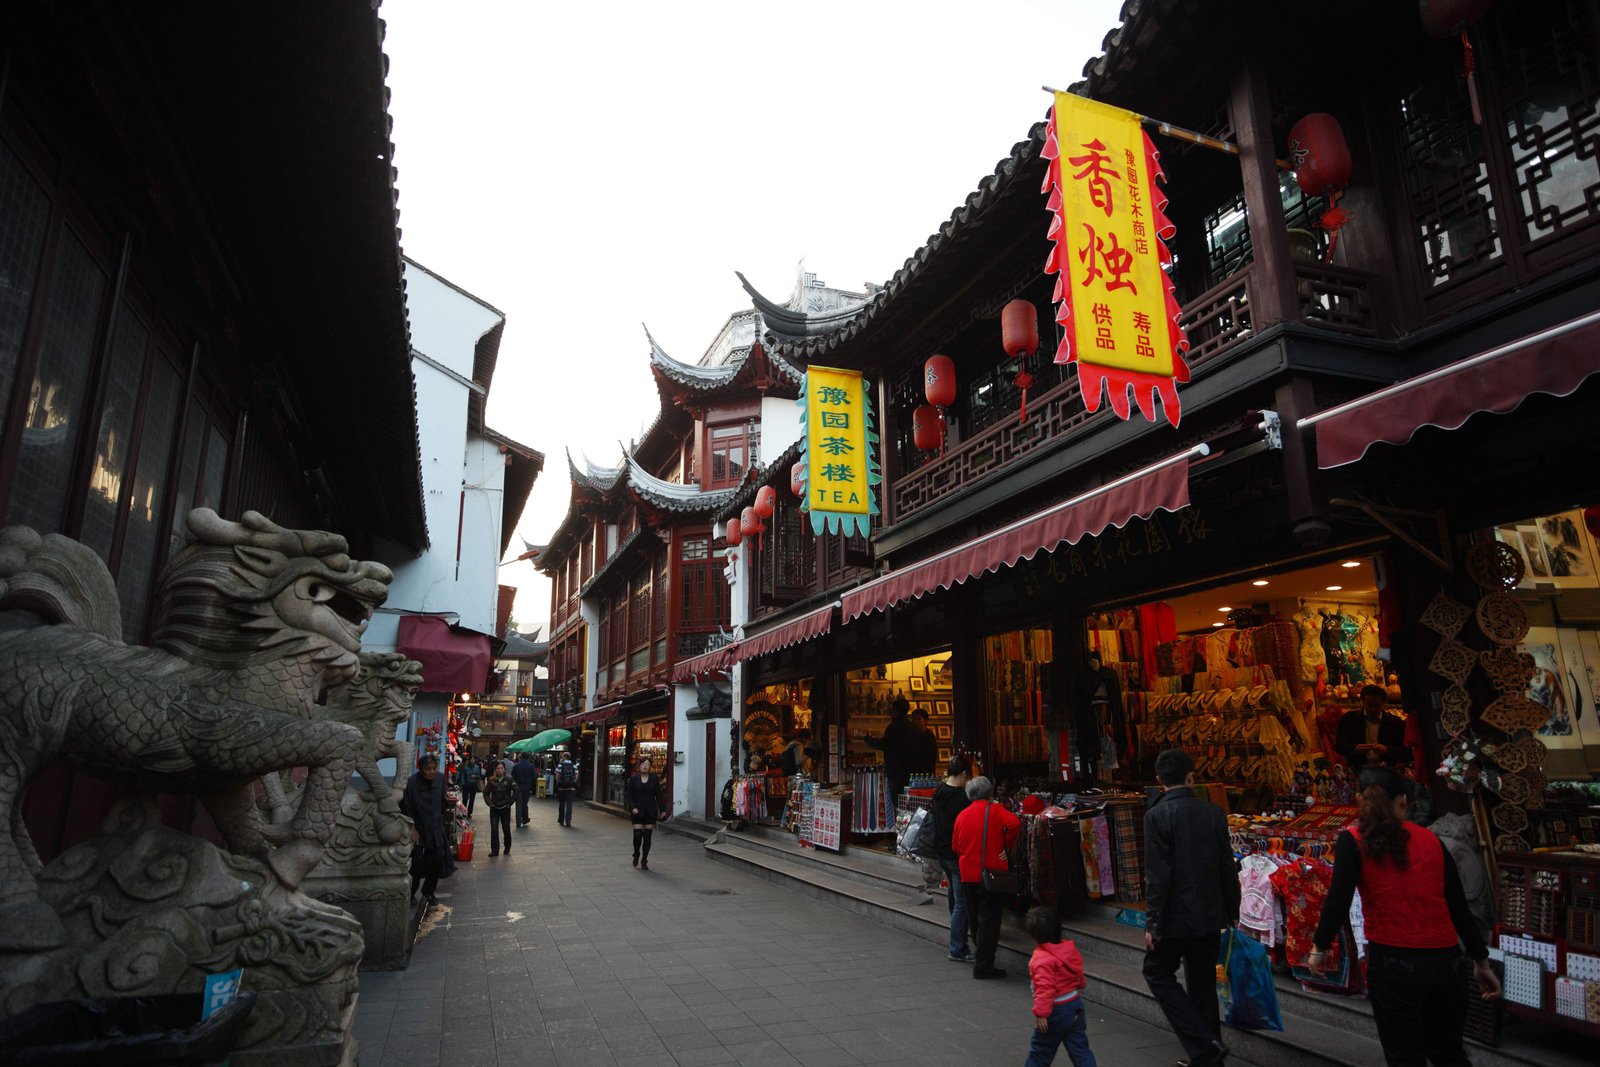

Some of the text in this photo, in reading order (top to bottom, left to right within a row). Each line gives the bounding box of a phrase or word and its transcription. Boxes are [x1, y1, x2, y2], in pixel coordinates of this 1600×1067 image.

[1068, 138, 1138, 296] 香烛
[1091, 302, 1116, 351] 供品
[1132, 311, 1156, 359] 寿品
[816, 386, 856, 483] 豫园茶楼
[817, 489, 860, 505] TEA
